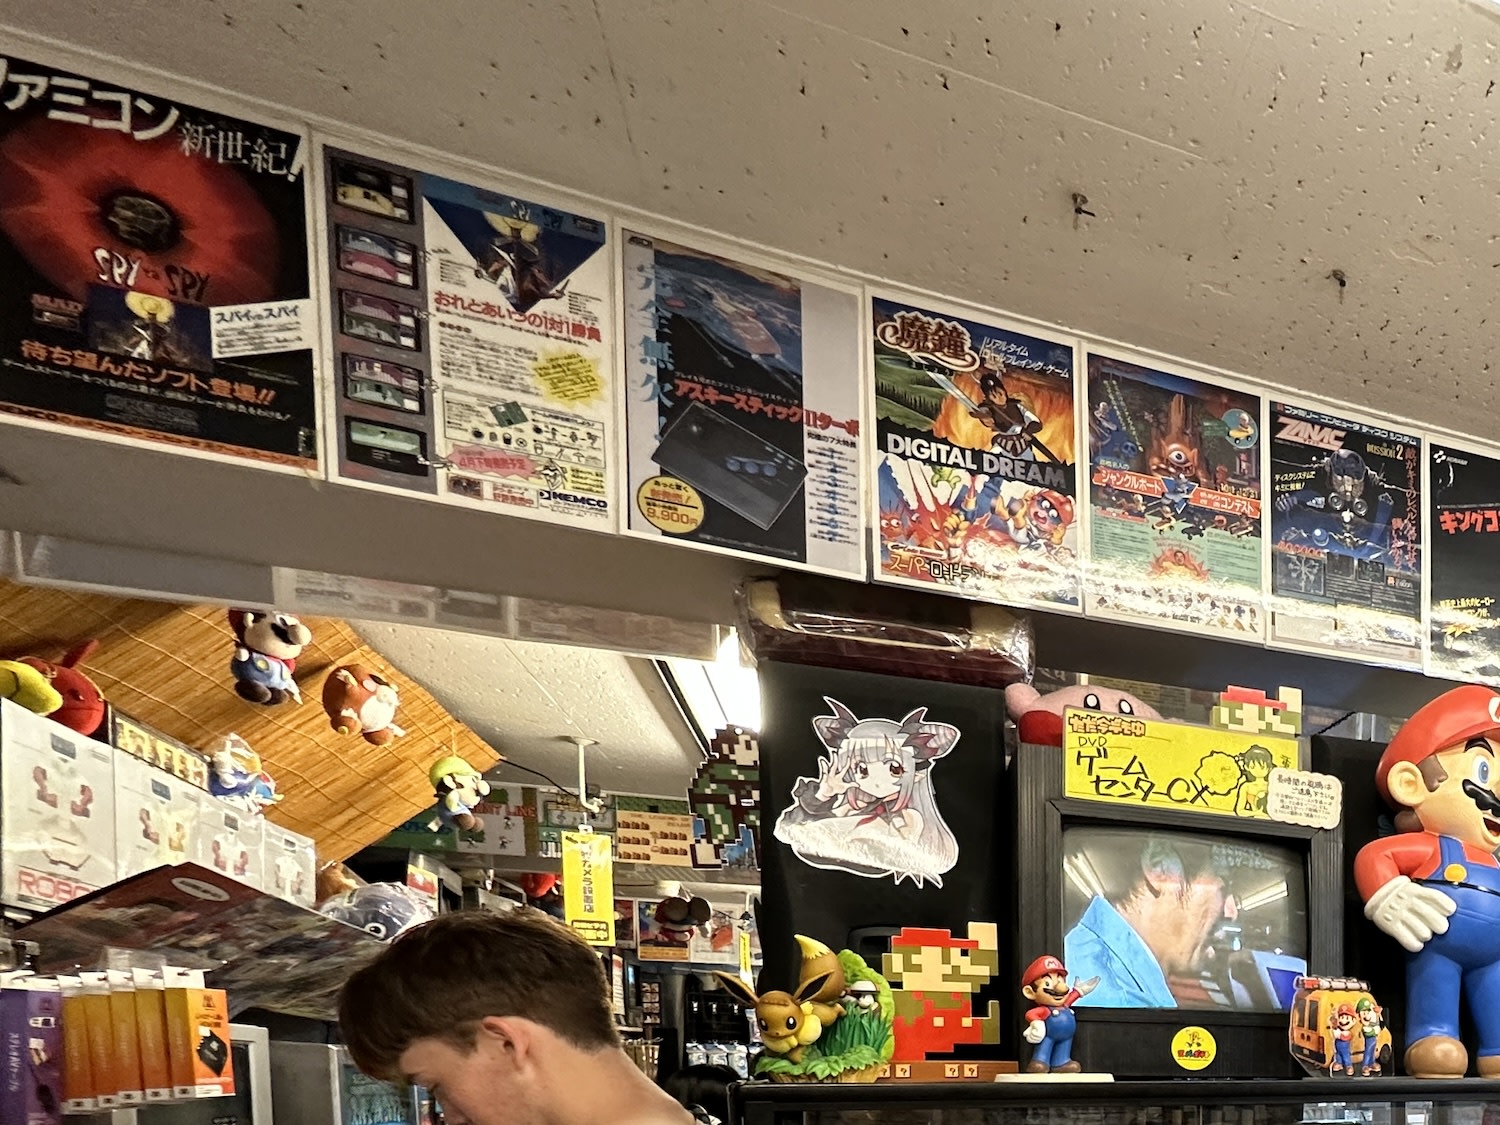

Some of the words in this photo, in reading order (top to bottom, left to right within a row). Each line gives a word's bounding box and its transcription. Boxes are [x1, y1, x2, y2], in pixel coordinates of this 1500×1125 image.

[0, 57, 180, 141] ァミコン
[178, 121, 306, 183] 新世紀!
[93, 247, 142, 287] SPY
[164, 263, 210, 301] SPY
[20, 339, 278, 407] 待ち望んだソフト登場!!
[1275, 416, 1348, 450] ZANAC
[886, 433, 978, 471] DIGITAL
[982, 455, 1068, 490] DREAM
[1076, 748, 1149, 778] ゲーム
[1078, 736, 1108, 748] DVD
[1090, 774, 1210, 806] センターCX
